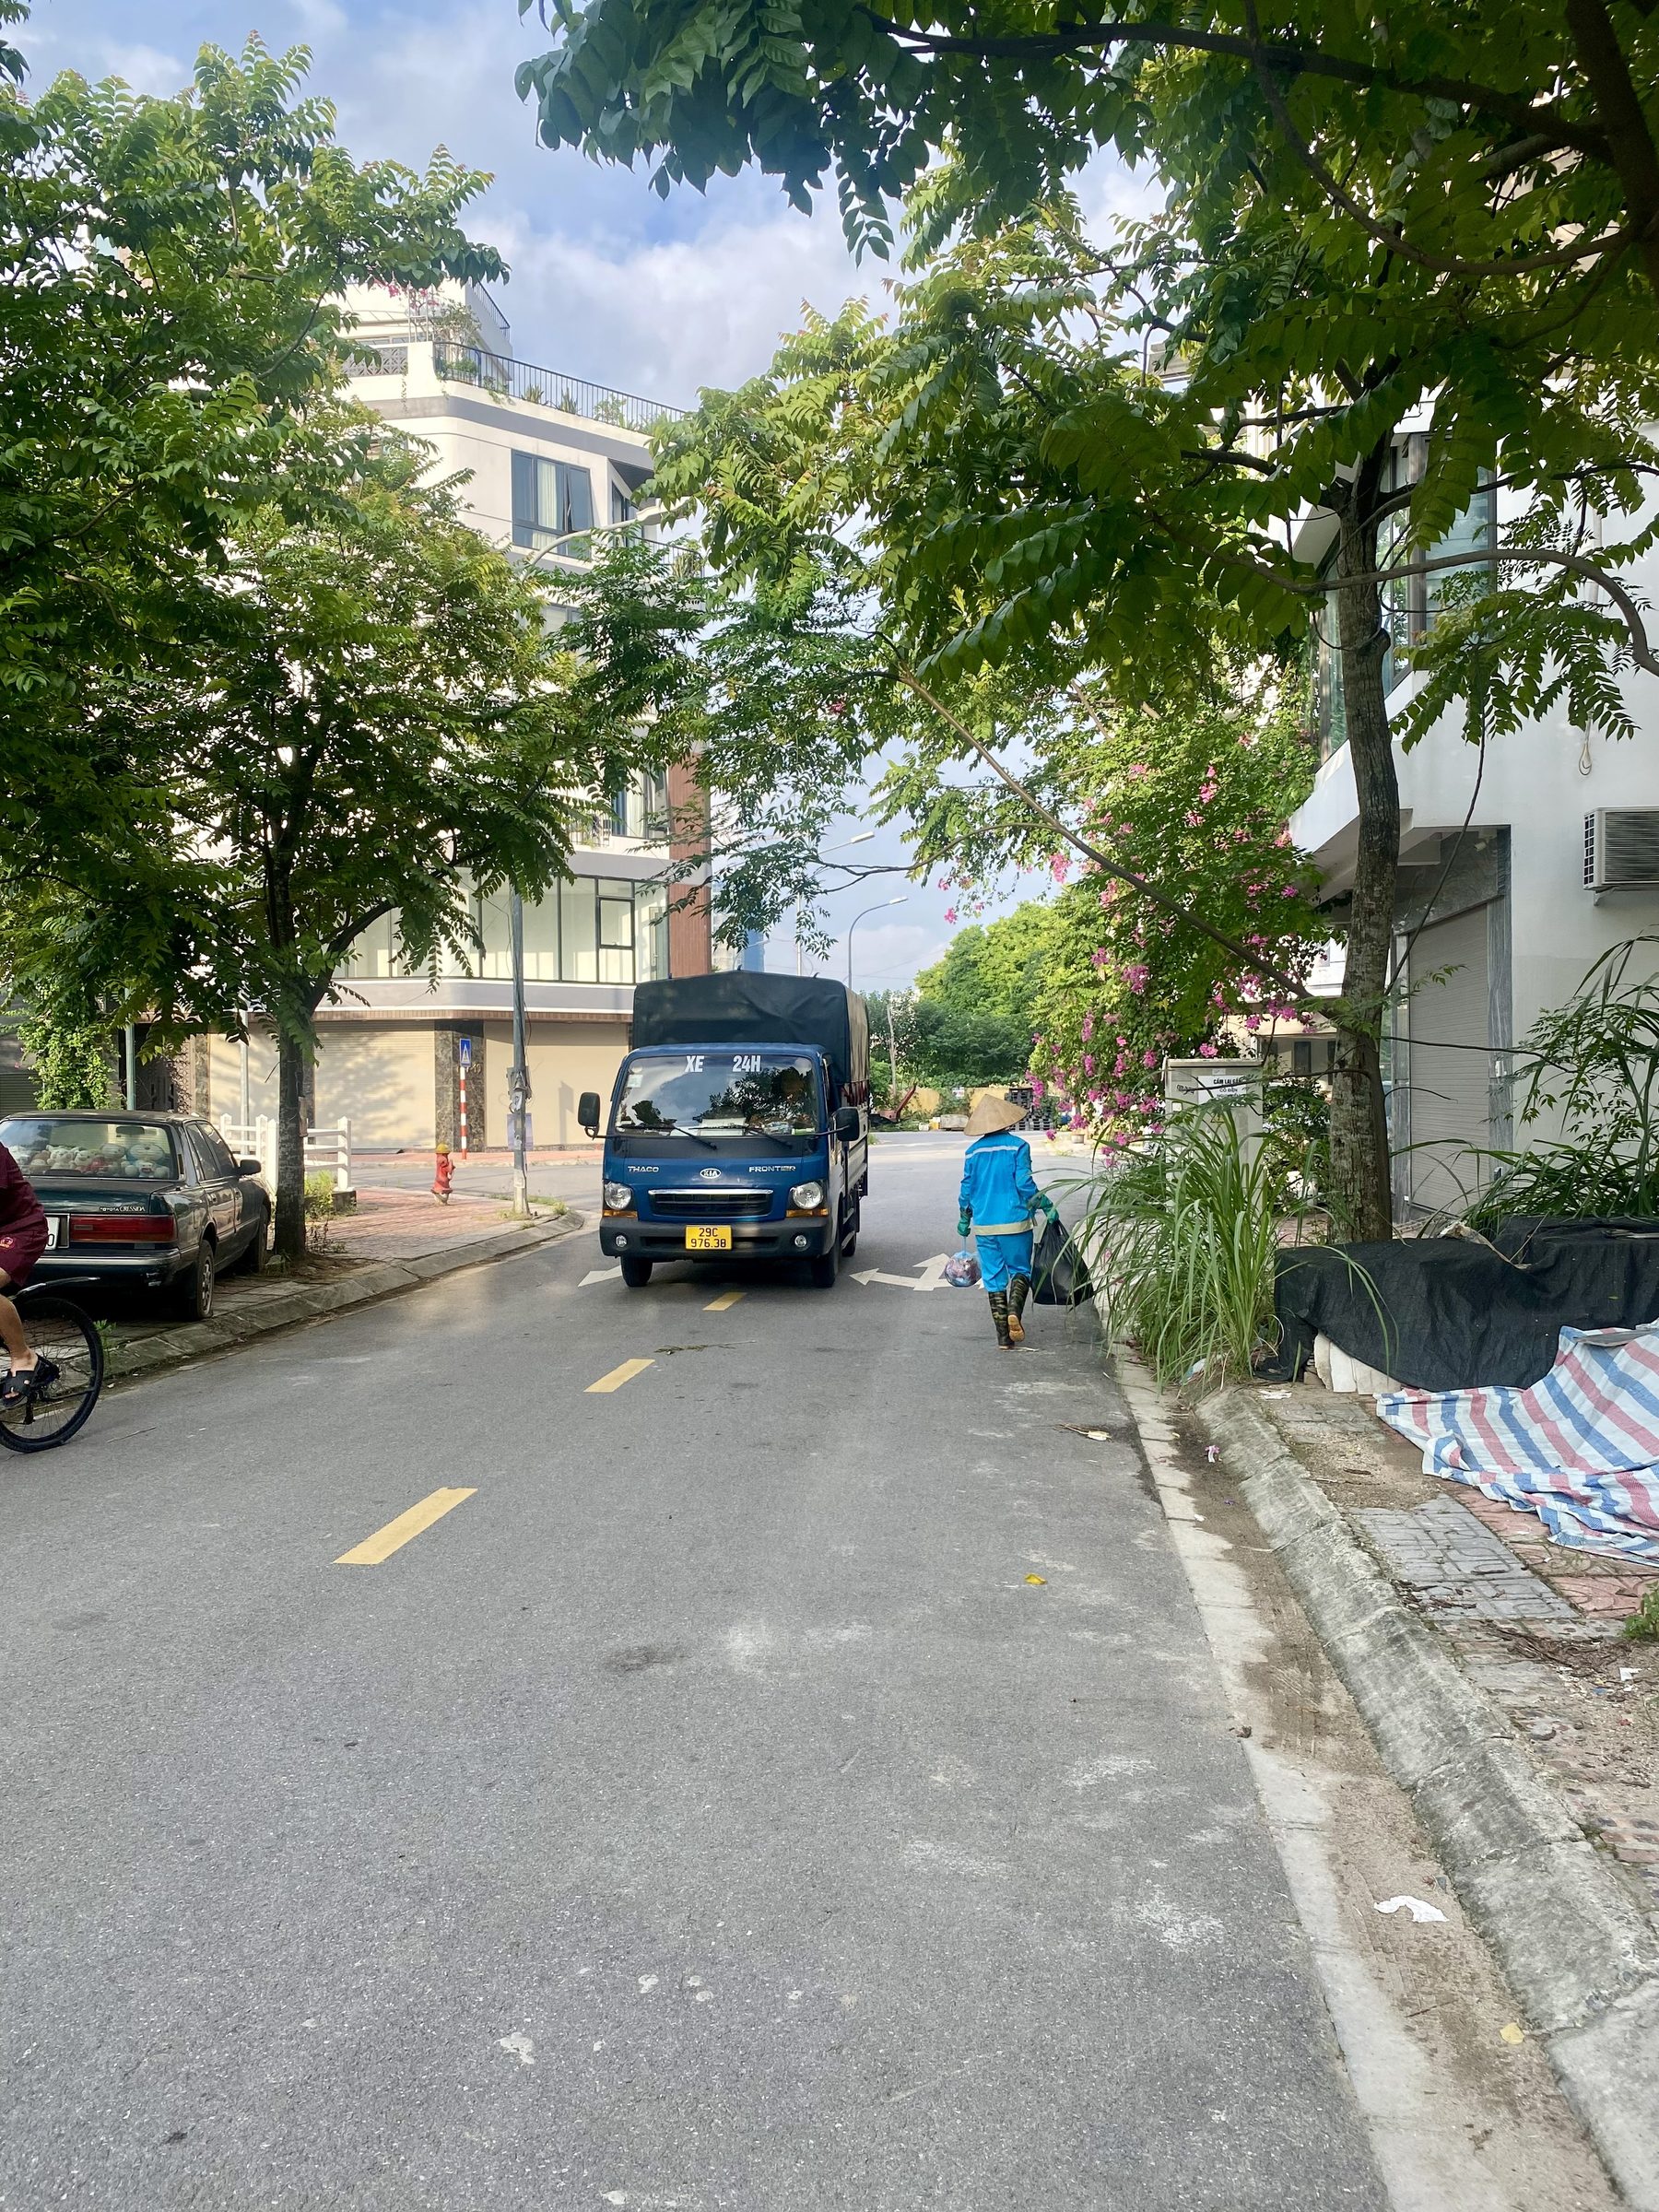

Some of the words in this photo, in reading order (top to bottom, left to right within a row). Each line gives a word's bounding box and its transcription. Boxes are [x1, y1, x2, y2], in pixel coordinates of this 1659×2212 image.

[685, 1055, 705, 1073] XE
[732, 1054, 761, 1073] 24H
[627, 1165, 660, 1173] THACO
[701, 1169, 720, 1178] KIA
[748, 1165, 796, 1173] FRONTIER
[699, 1228, 719, 1238] 29C
[690, 1238, 727, 1248] 976.38
